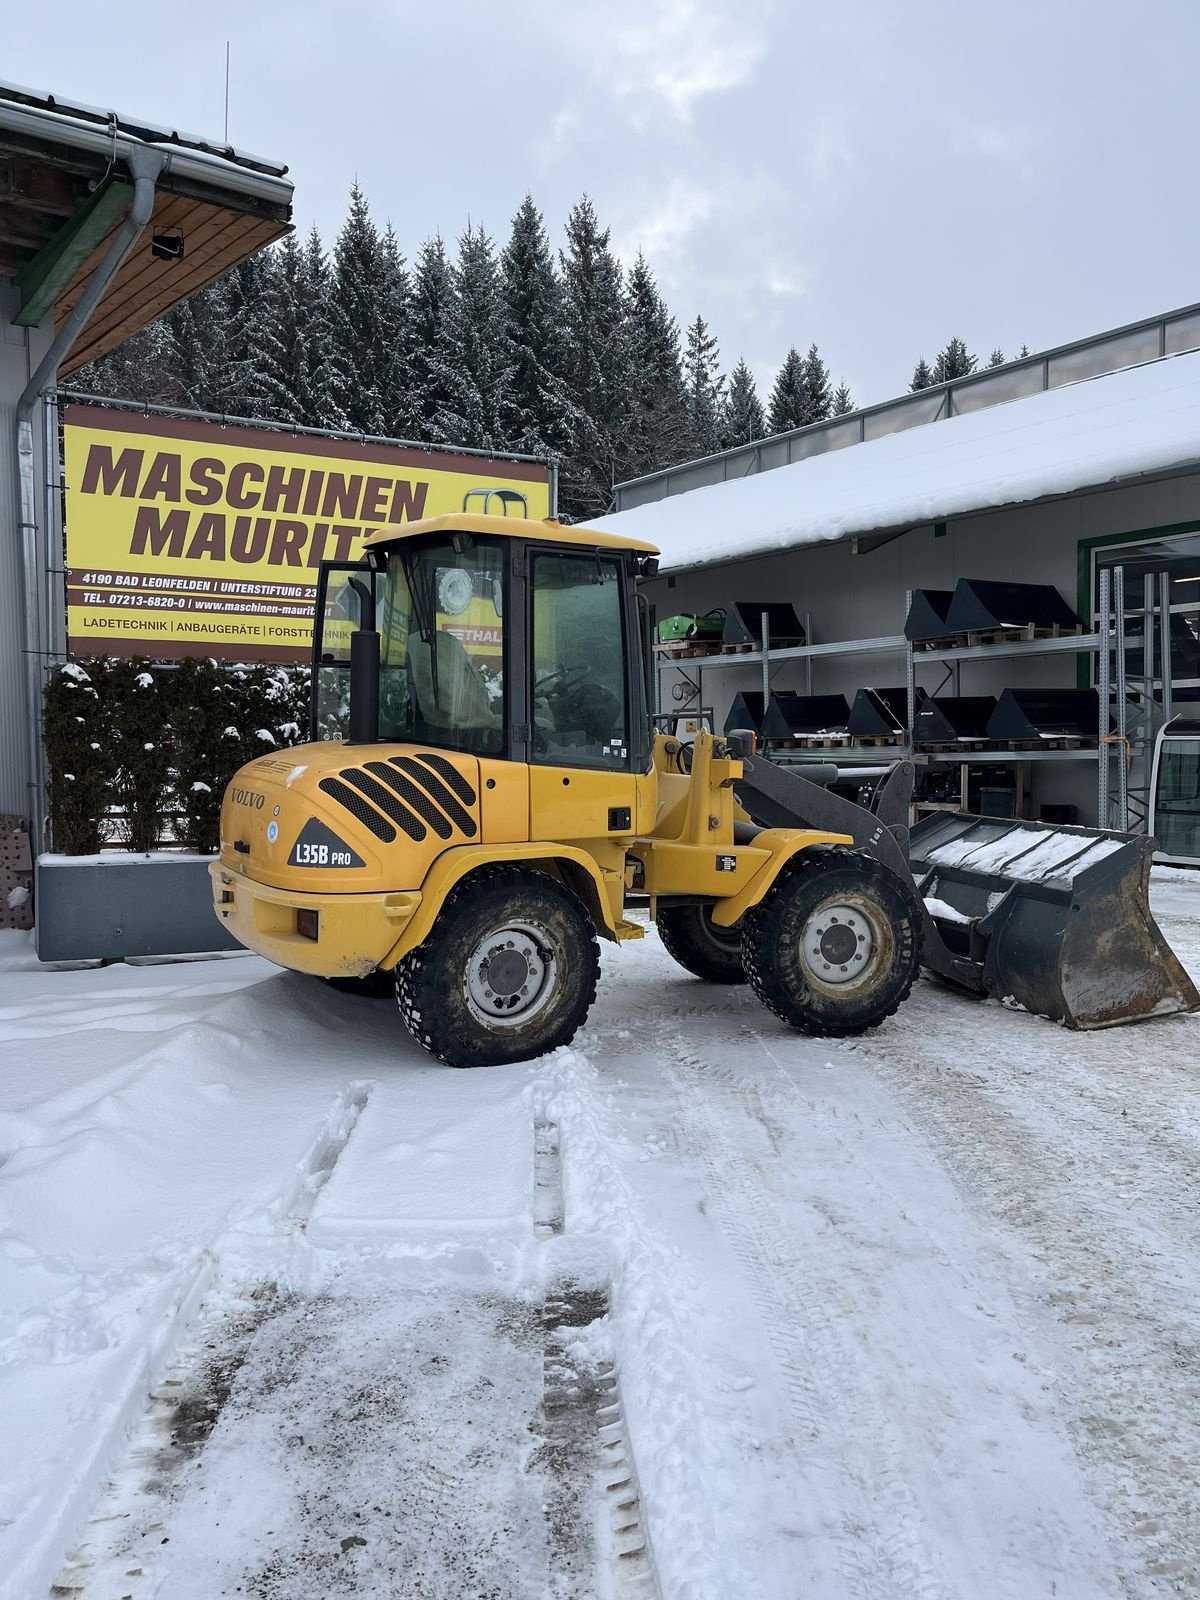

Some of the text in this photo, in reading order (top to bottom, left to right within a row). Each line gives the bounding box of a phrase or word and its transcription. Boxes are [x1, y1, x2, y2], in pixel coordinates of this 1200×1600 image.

[80, 444, 429, 524] MASCHINEN
[82, 573, 317, 598] 4190 BAD LEONFELDEN UNTERSTIFTUNG 23
[83, 592, 106, 604] TEL.
[109, 594, 185, 608] 07213-6820-0
[83, 618, 350, 640] LADETECHNIK ANBAUGERÄTE FORSTTEHNIK
[231, 788, 265, 810] VOLVO
[296, 843, 351, 865] L35B PRO
